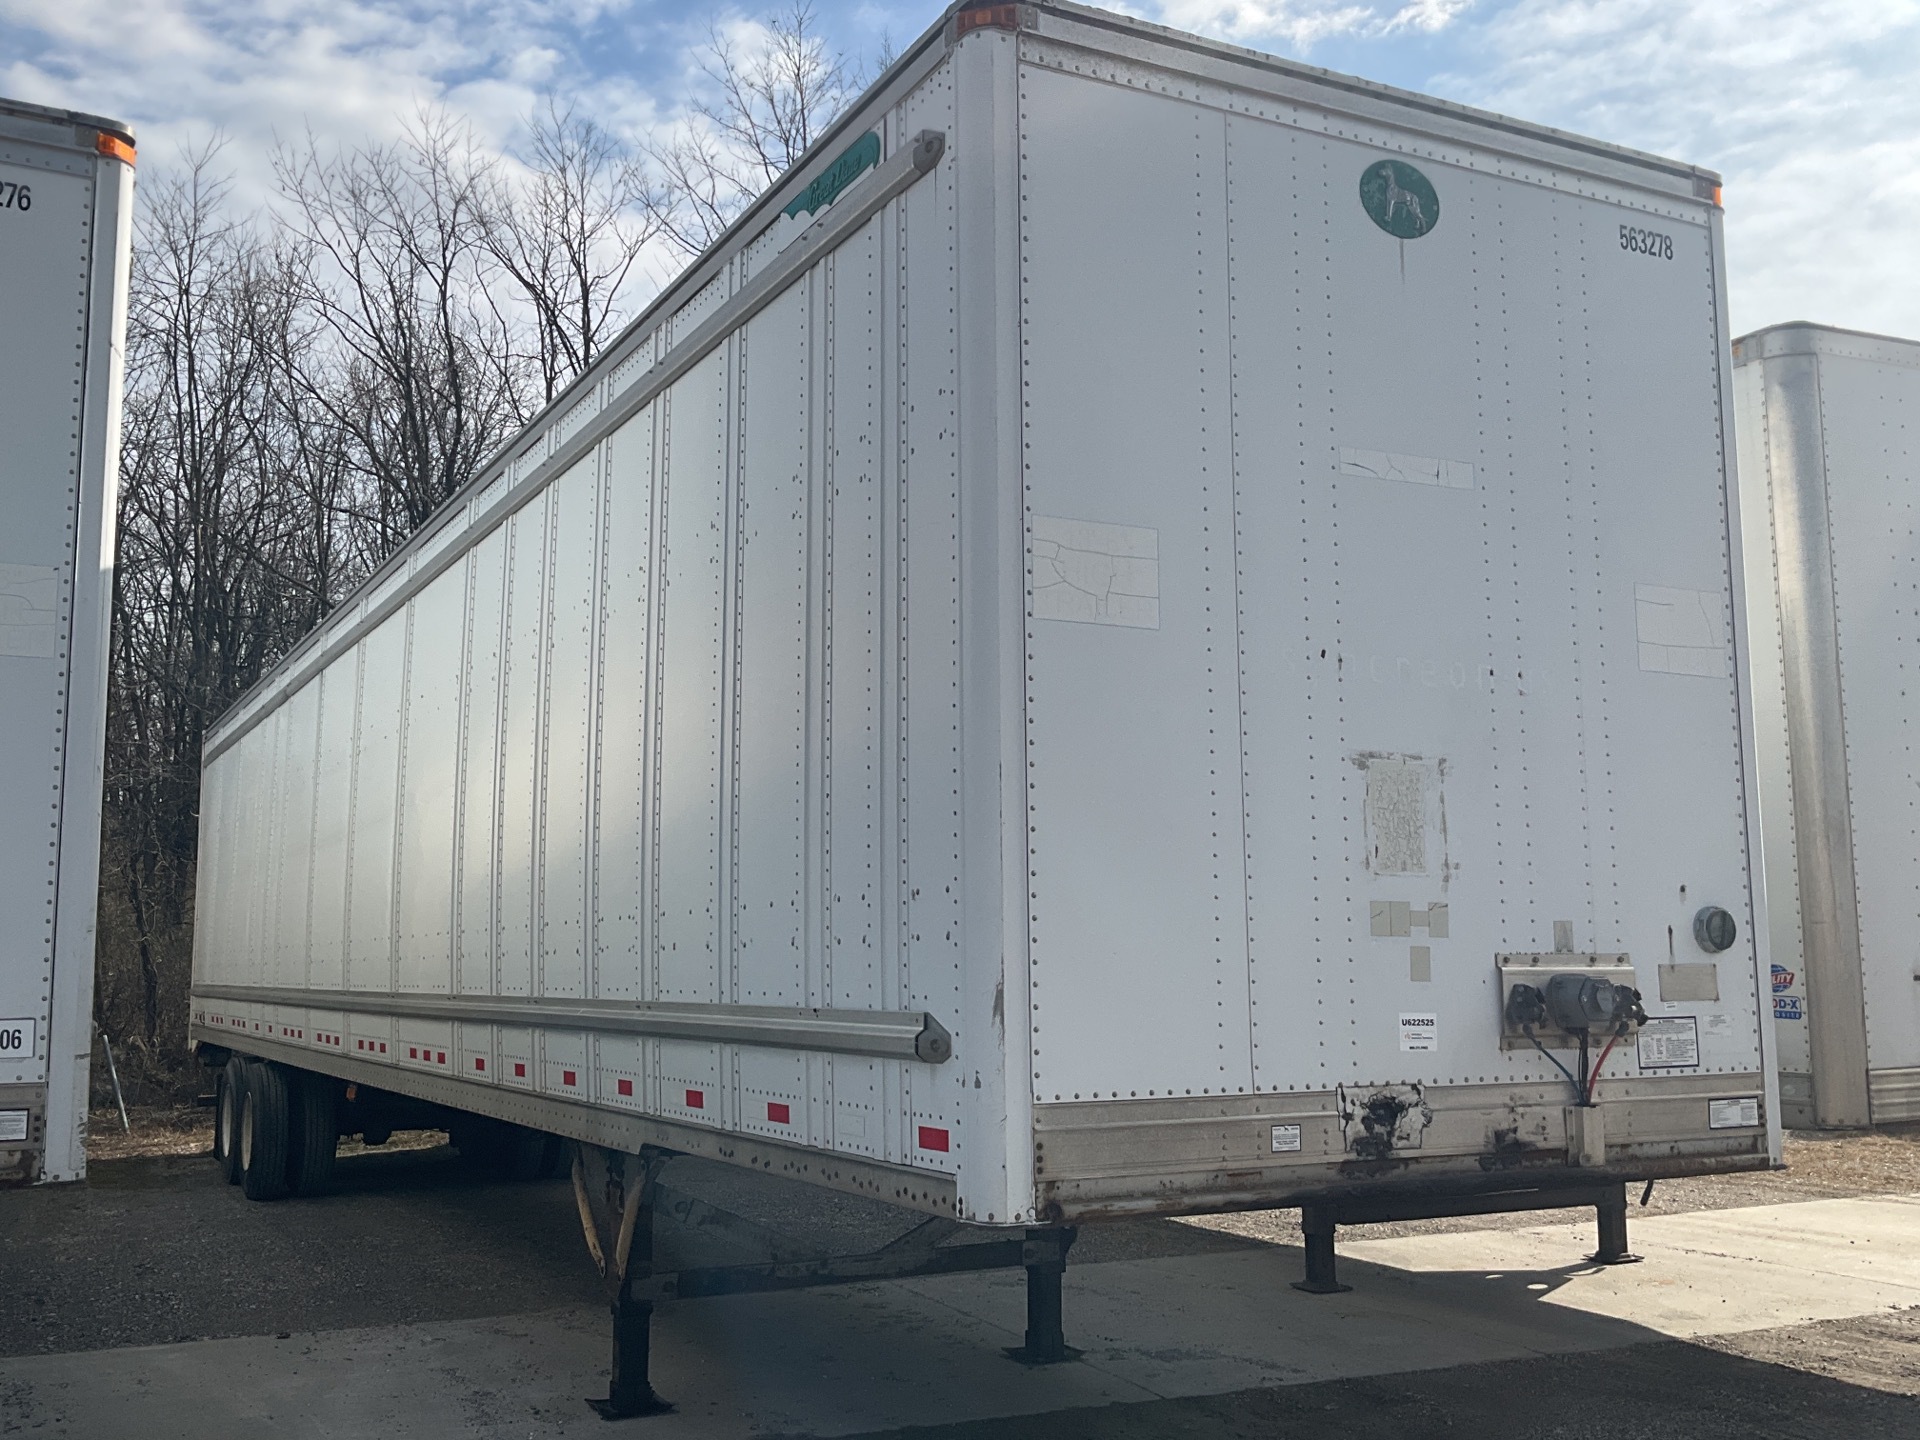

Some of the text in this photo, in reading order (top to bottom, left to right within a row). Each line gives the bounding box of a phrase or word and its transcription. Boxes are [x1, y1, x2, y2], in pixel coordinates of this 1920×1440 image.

[0, 181, 31, 211] 76
[1619, 224, 1673, 260] 563278
[1401, 1018, 1434, 1026] U622525
[0, 1029, 22, 1050] 06
